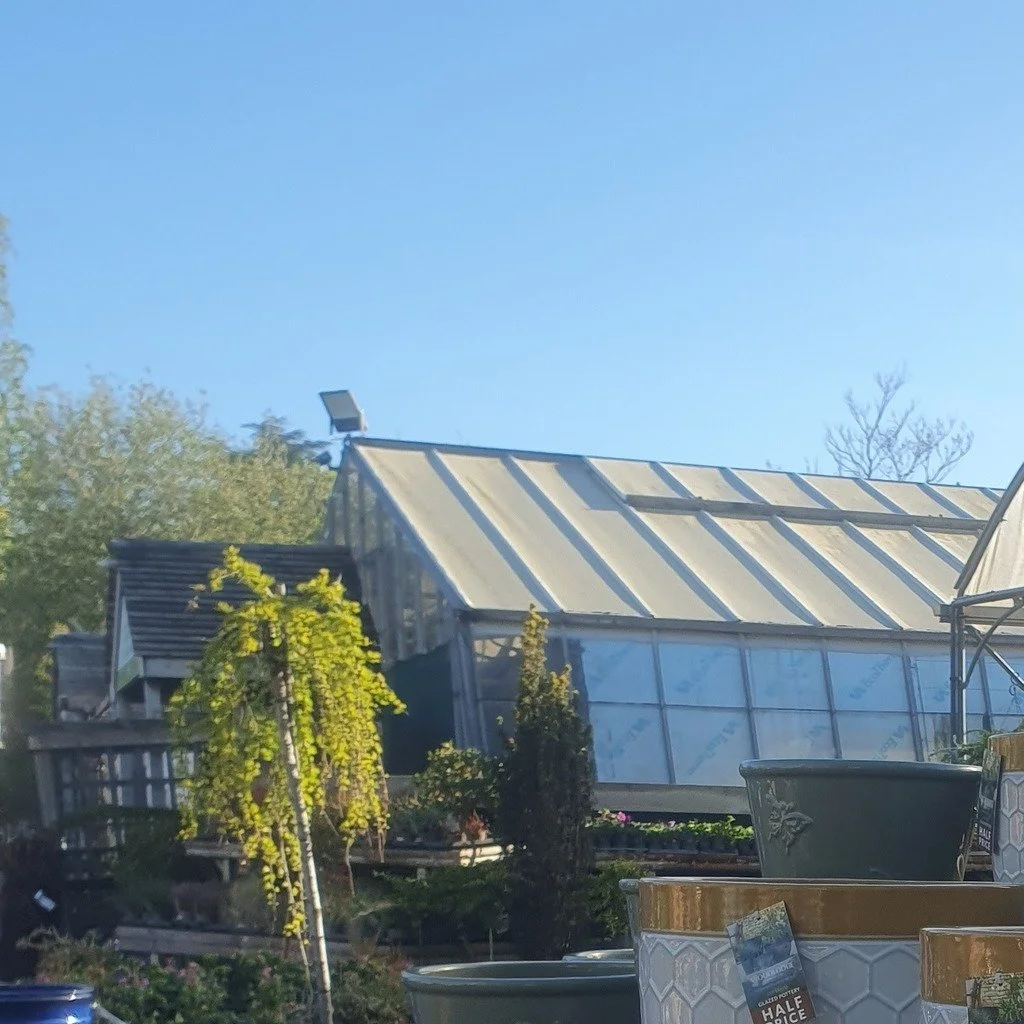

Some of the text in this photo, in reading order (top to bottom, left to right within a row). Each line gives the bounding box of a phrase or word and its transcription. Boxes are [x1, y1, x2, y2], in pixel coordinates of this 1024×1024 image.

[979, 826, 992, 840] HALF
[978, 837, 991, 851] PRICE
[779, 986, 800, 999] POTTERY
[762, 995, 803, 1021] HALF
